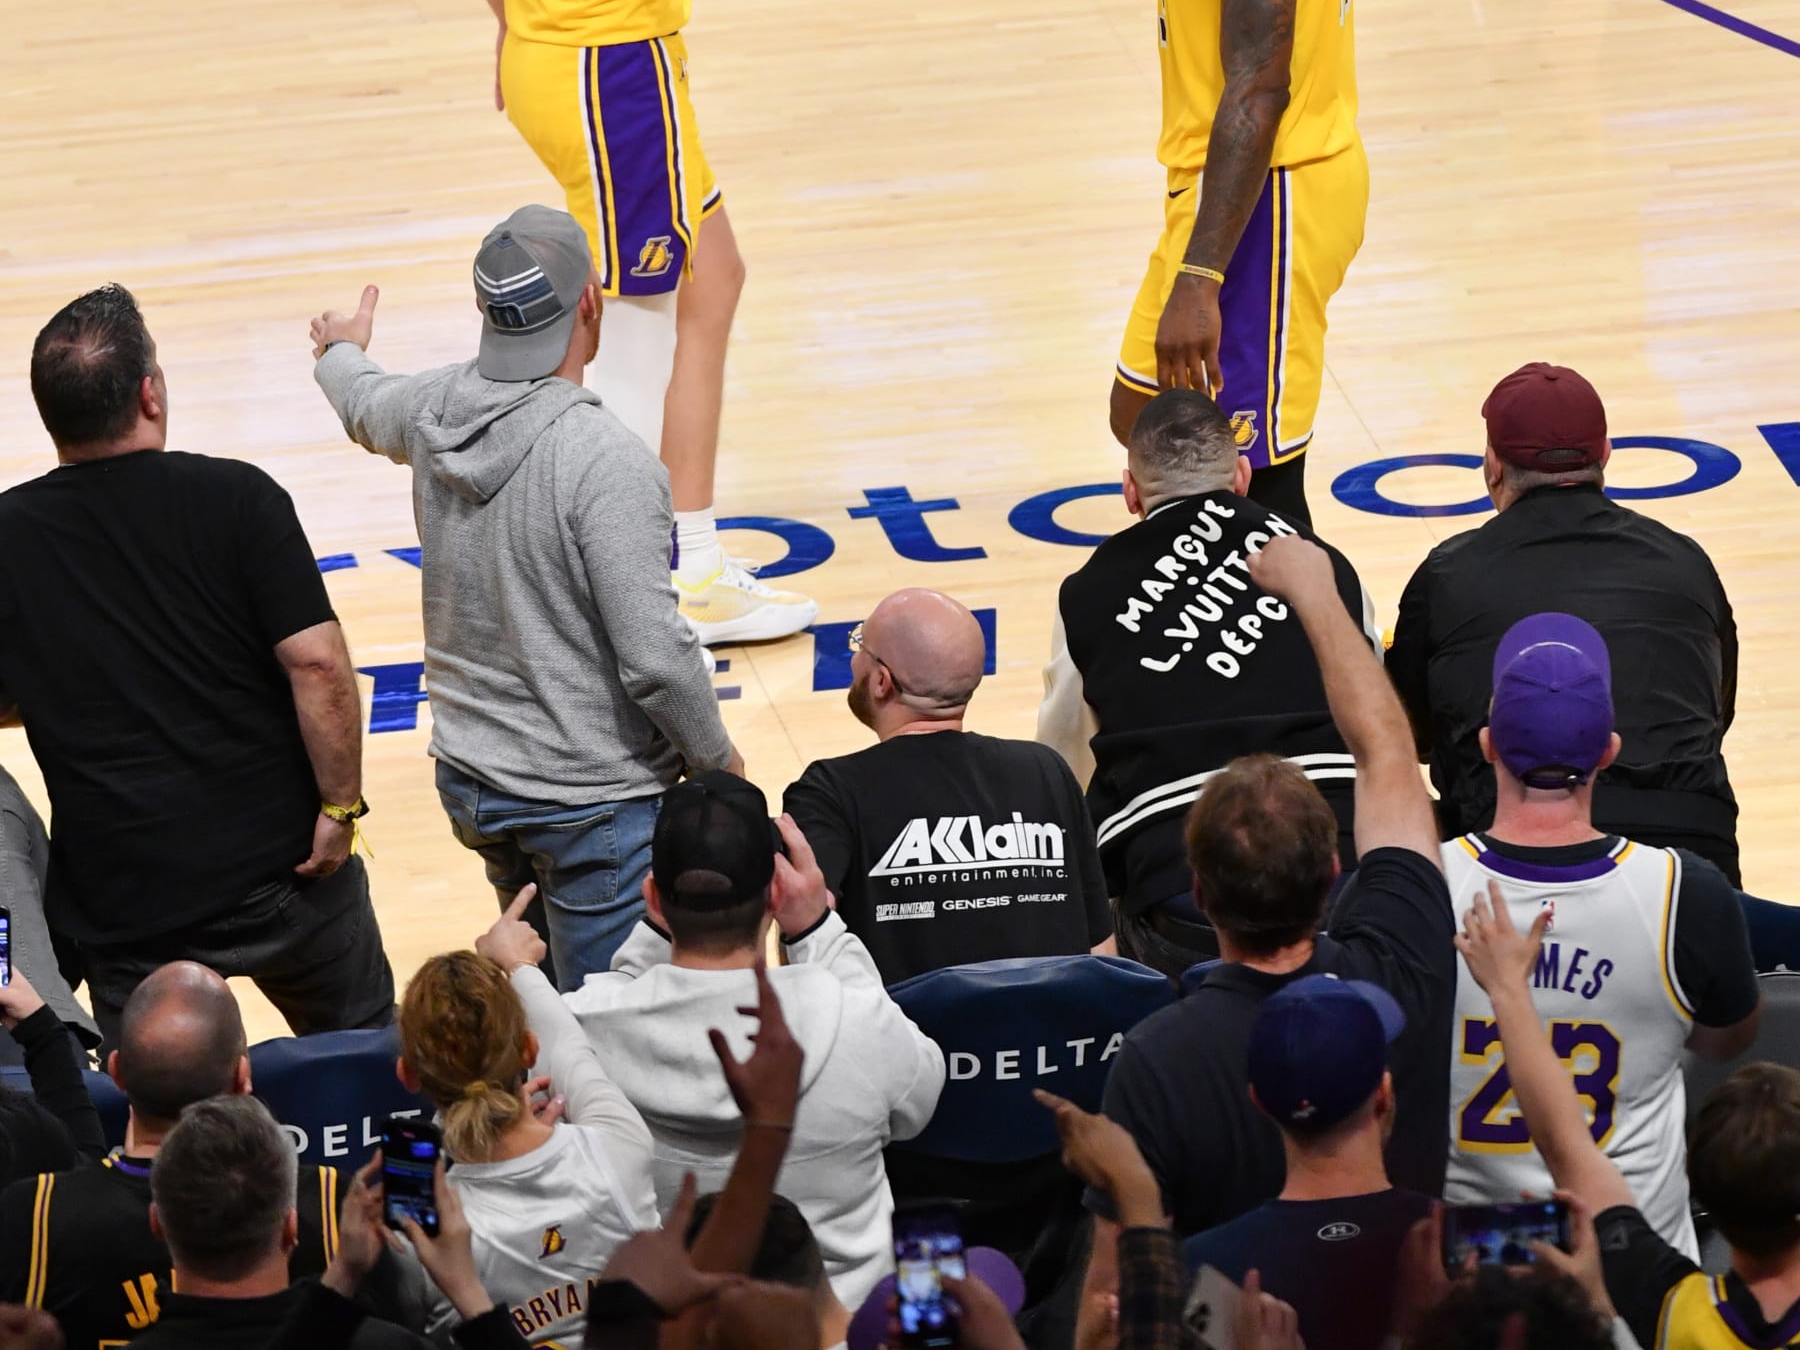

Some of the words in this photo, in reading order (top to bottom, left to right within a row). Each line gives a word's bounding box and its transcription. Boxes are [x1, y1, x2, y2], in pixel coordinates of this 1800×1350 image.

[1115, 499, 1236, 633] MARQUE
[876, 903, 898, 917] SUPER
[899, 901, 935, 915] NINTENDO
[942, 896, 1010, 911] GENESIS
[1533, 943, 1614, 1000] MES
[281, 1108, 423, 1158] DEL
[510, 1278, 598, 1338] BRYA
